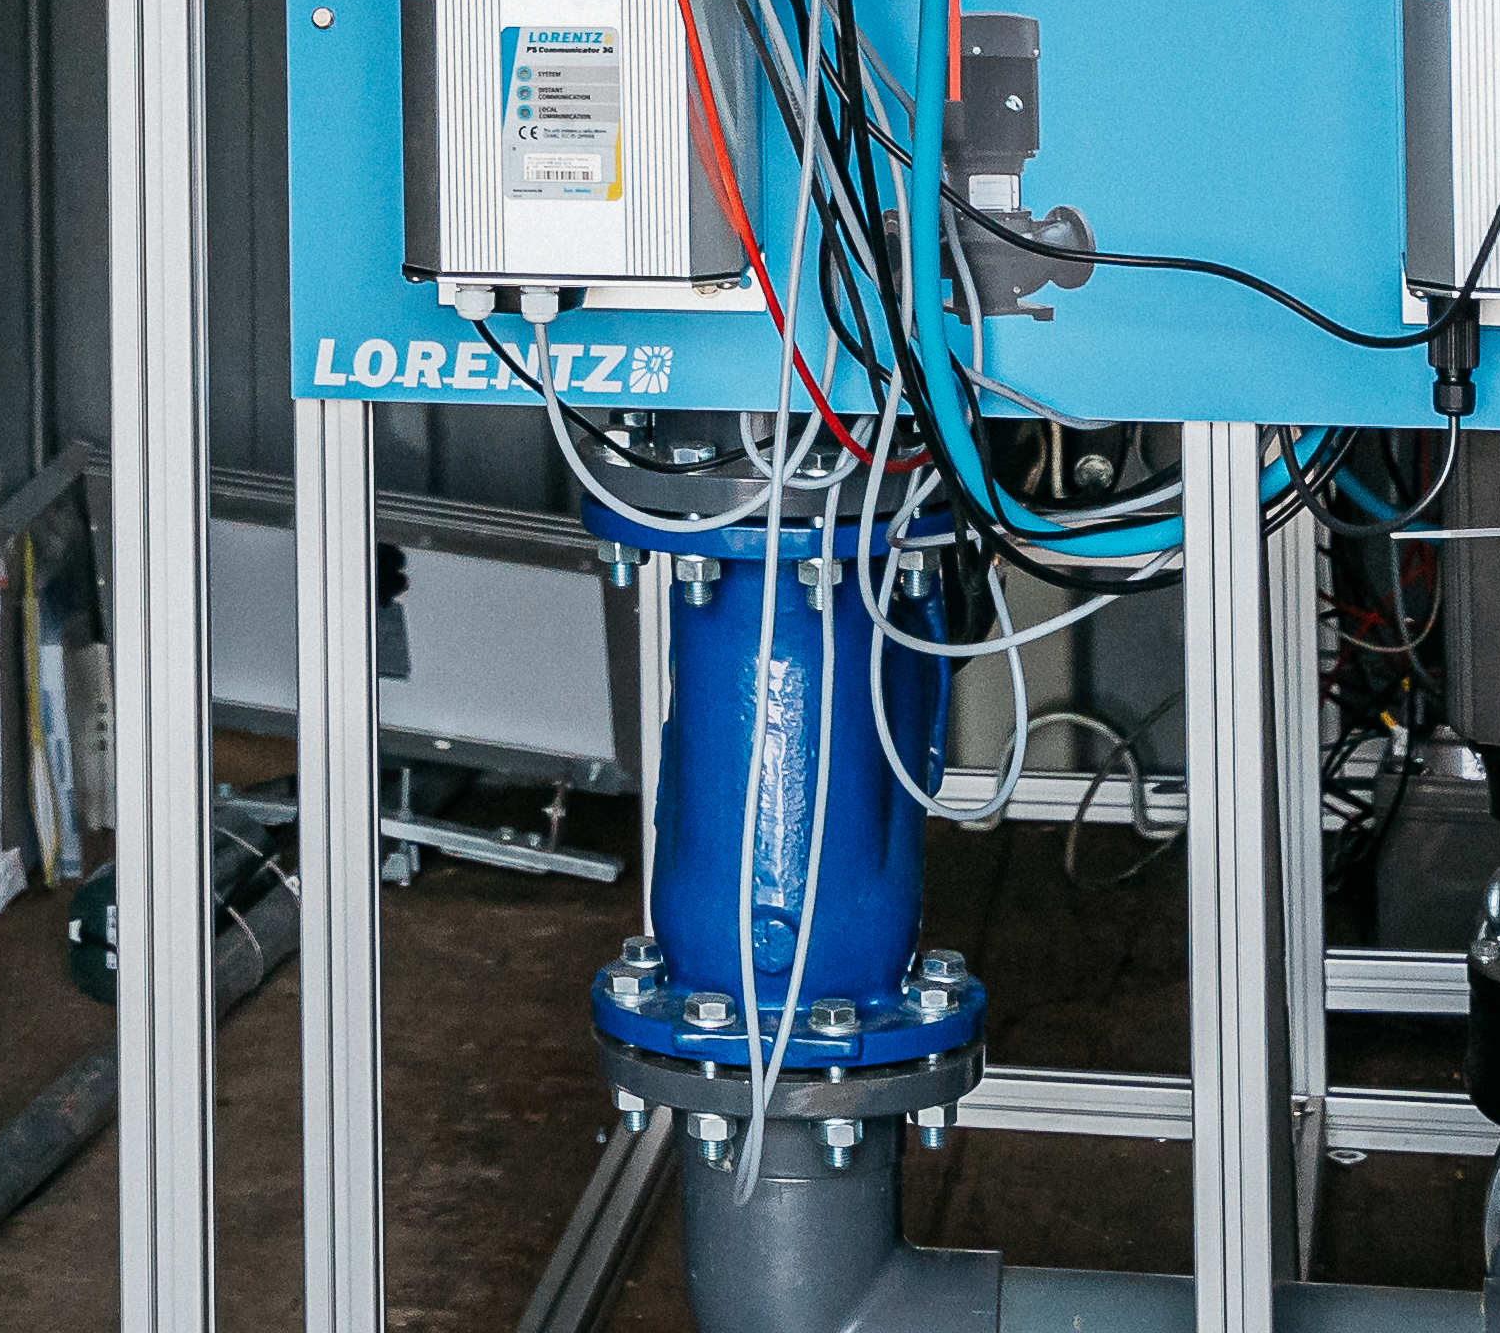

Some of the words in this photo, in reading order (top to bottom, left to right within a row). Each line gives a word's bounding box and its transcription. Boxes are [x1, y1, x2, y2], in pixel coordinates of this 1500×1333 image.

[529, 31, 603, 44] LORENTZ
[539, 46, 600, 54] Communicator
[313, 337, 628, 394] LORENTZ
